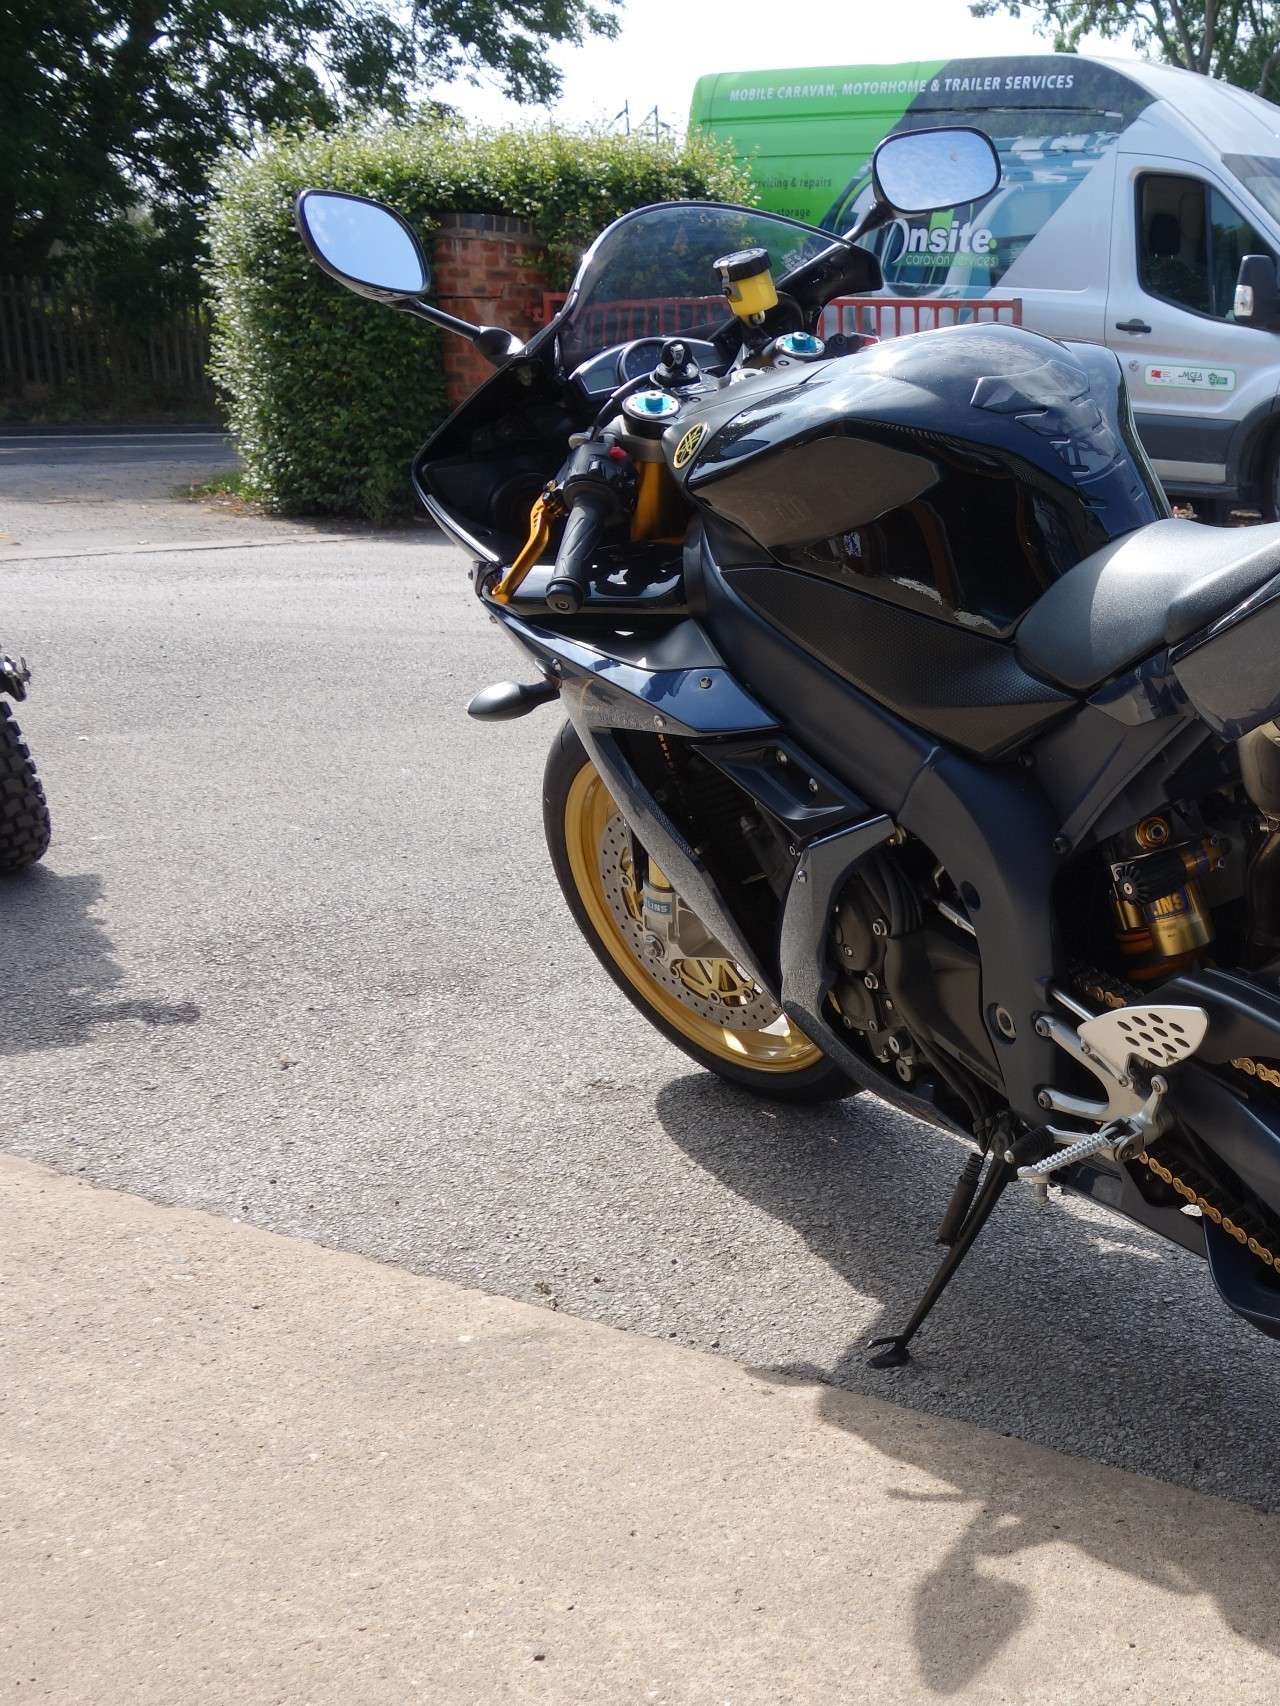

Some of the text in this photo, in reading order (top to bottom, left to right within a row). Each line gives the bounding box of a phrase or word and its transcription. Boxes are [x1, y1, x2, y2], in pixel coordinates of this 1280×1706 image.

[730, 74, 1074, 102] MOBILE CARAVAN, MOTORHOME & TRAILER SERVICES
[800, 177, 832, 190] repairs
[893, 217, 993, 264] Onsite
[905, 254, 950, 265] caravan
